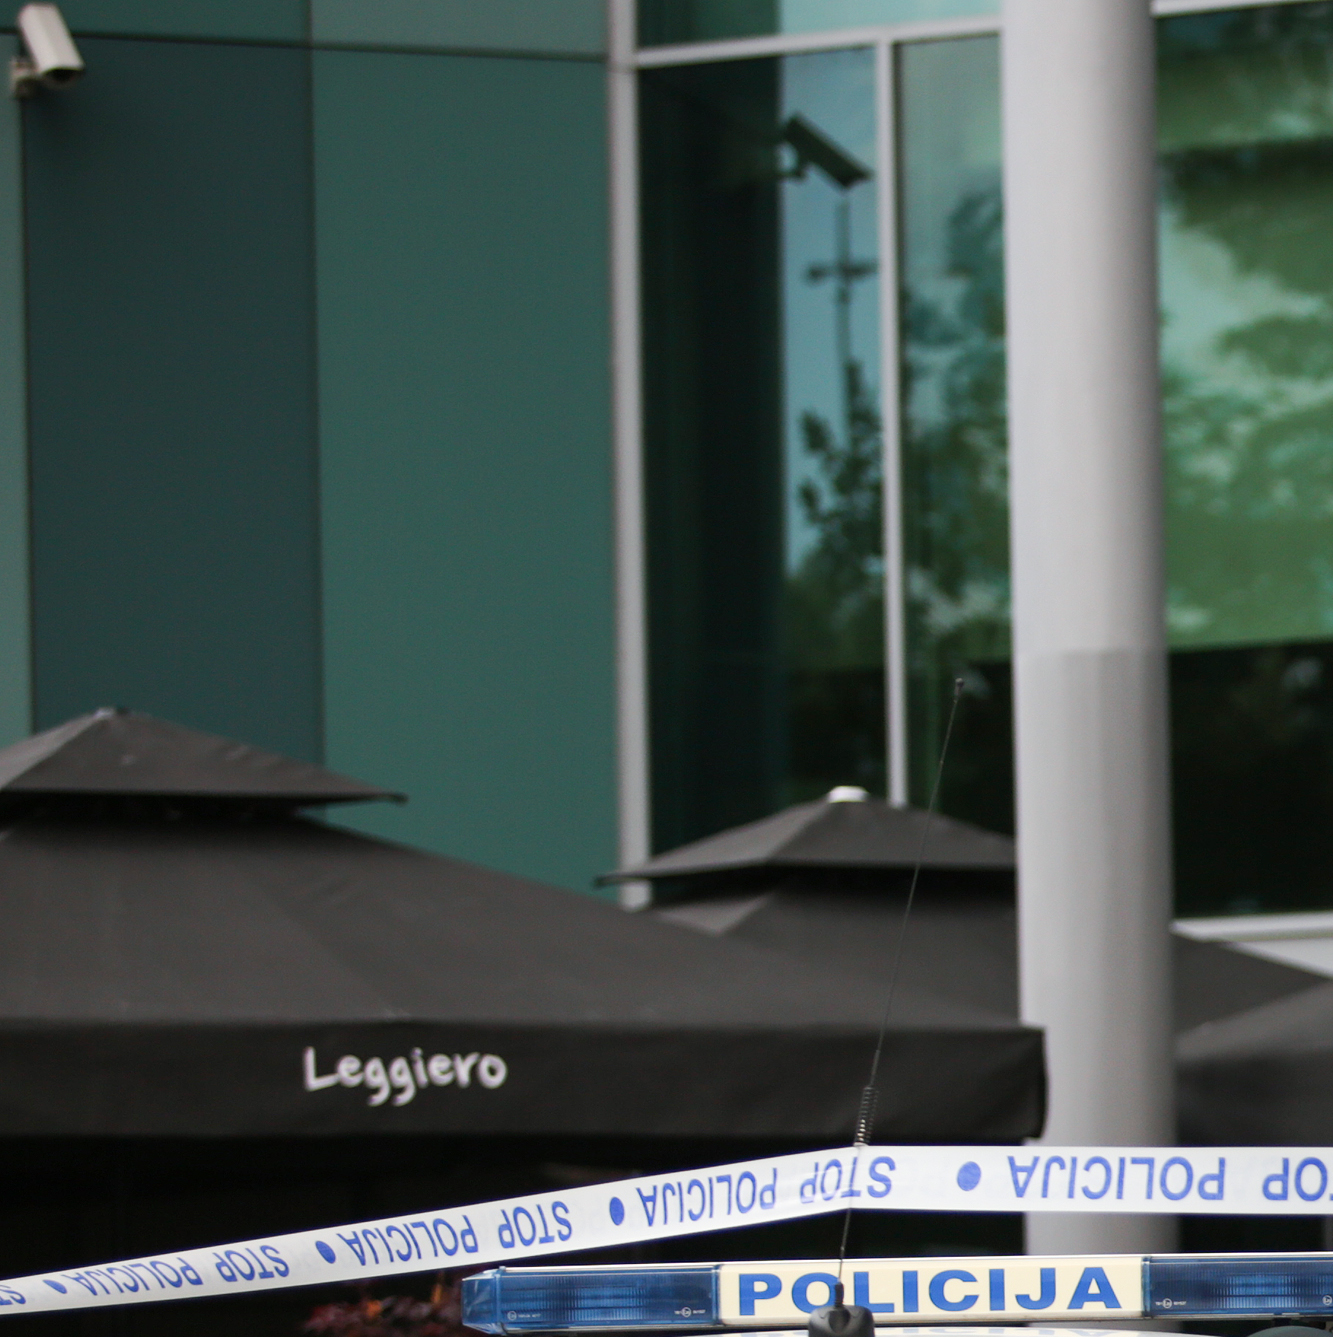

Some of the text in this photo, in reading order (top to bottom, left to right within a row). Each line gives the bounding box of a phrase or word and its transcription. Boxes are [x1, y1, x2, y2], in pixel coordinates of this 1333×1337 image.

[303, 1046, 508, 1107] Leggiero
[636, 1155, 896, 1227] STOP POLICIJA
[1007, 1156, 1226, 1202] POLICIJA
[338, 1200, 573, 1267] STOP POLICIJA
[62, 1256, 203, 1297] POLICIJA
[213, 1244, 290, 1283] STOP
[738, 1266, 1122, 1316] POLICIJA
